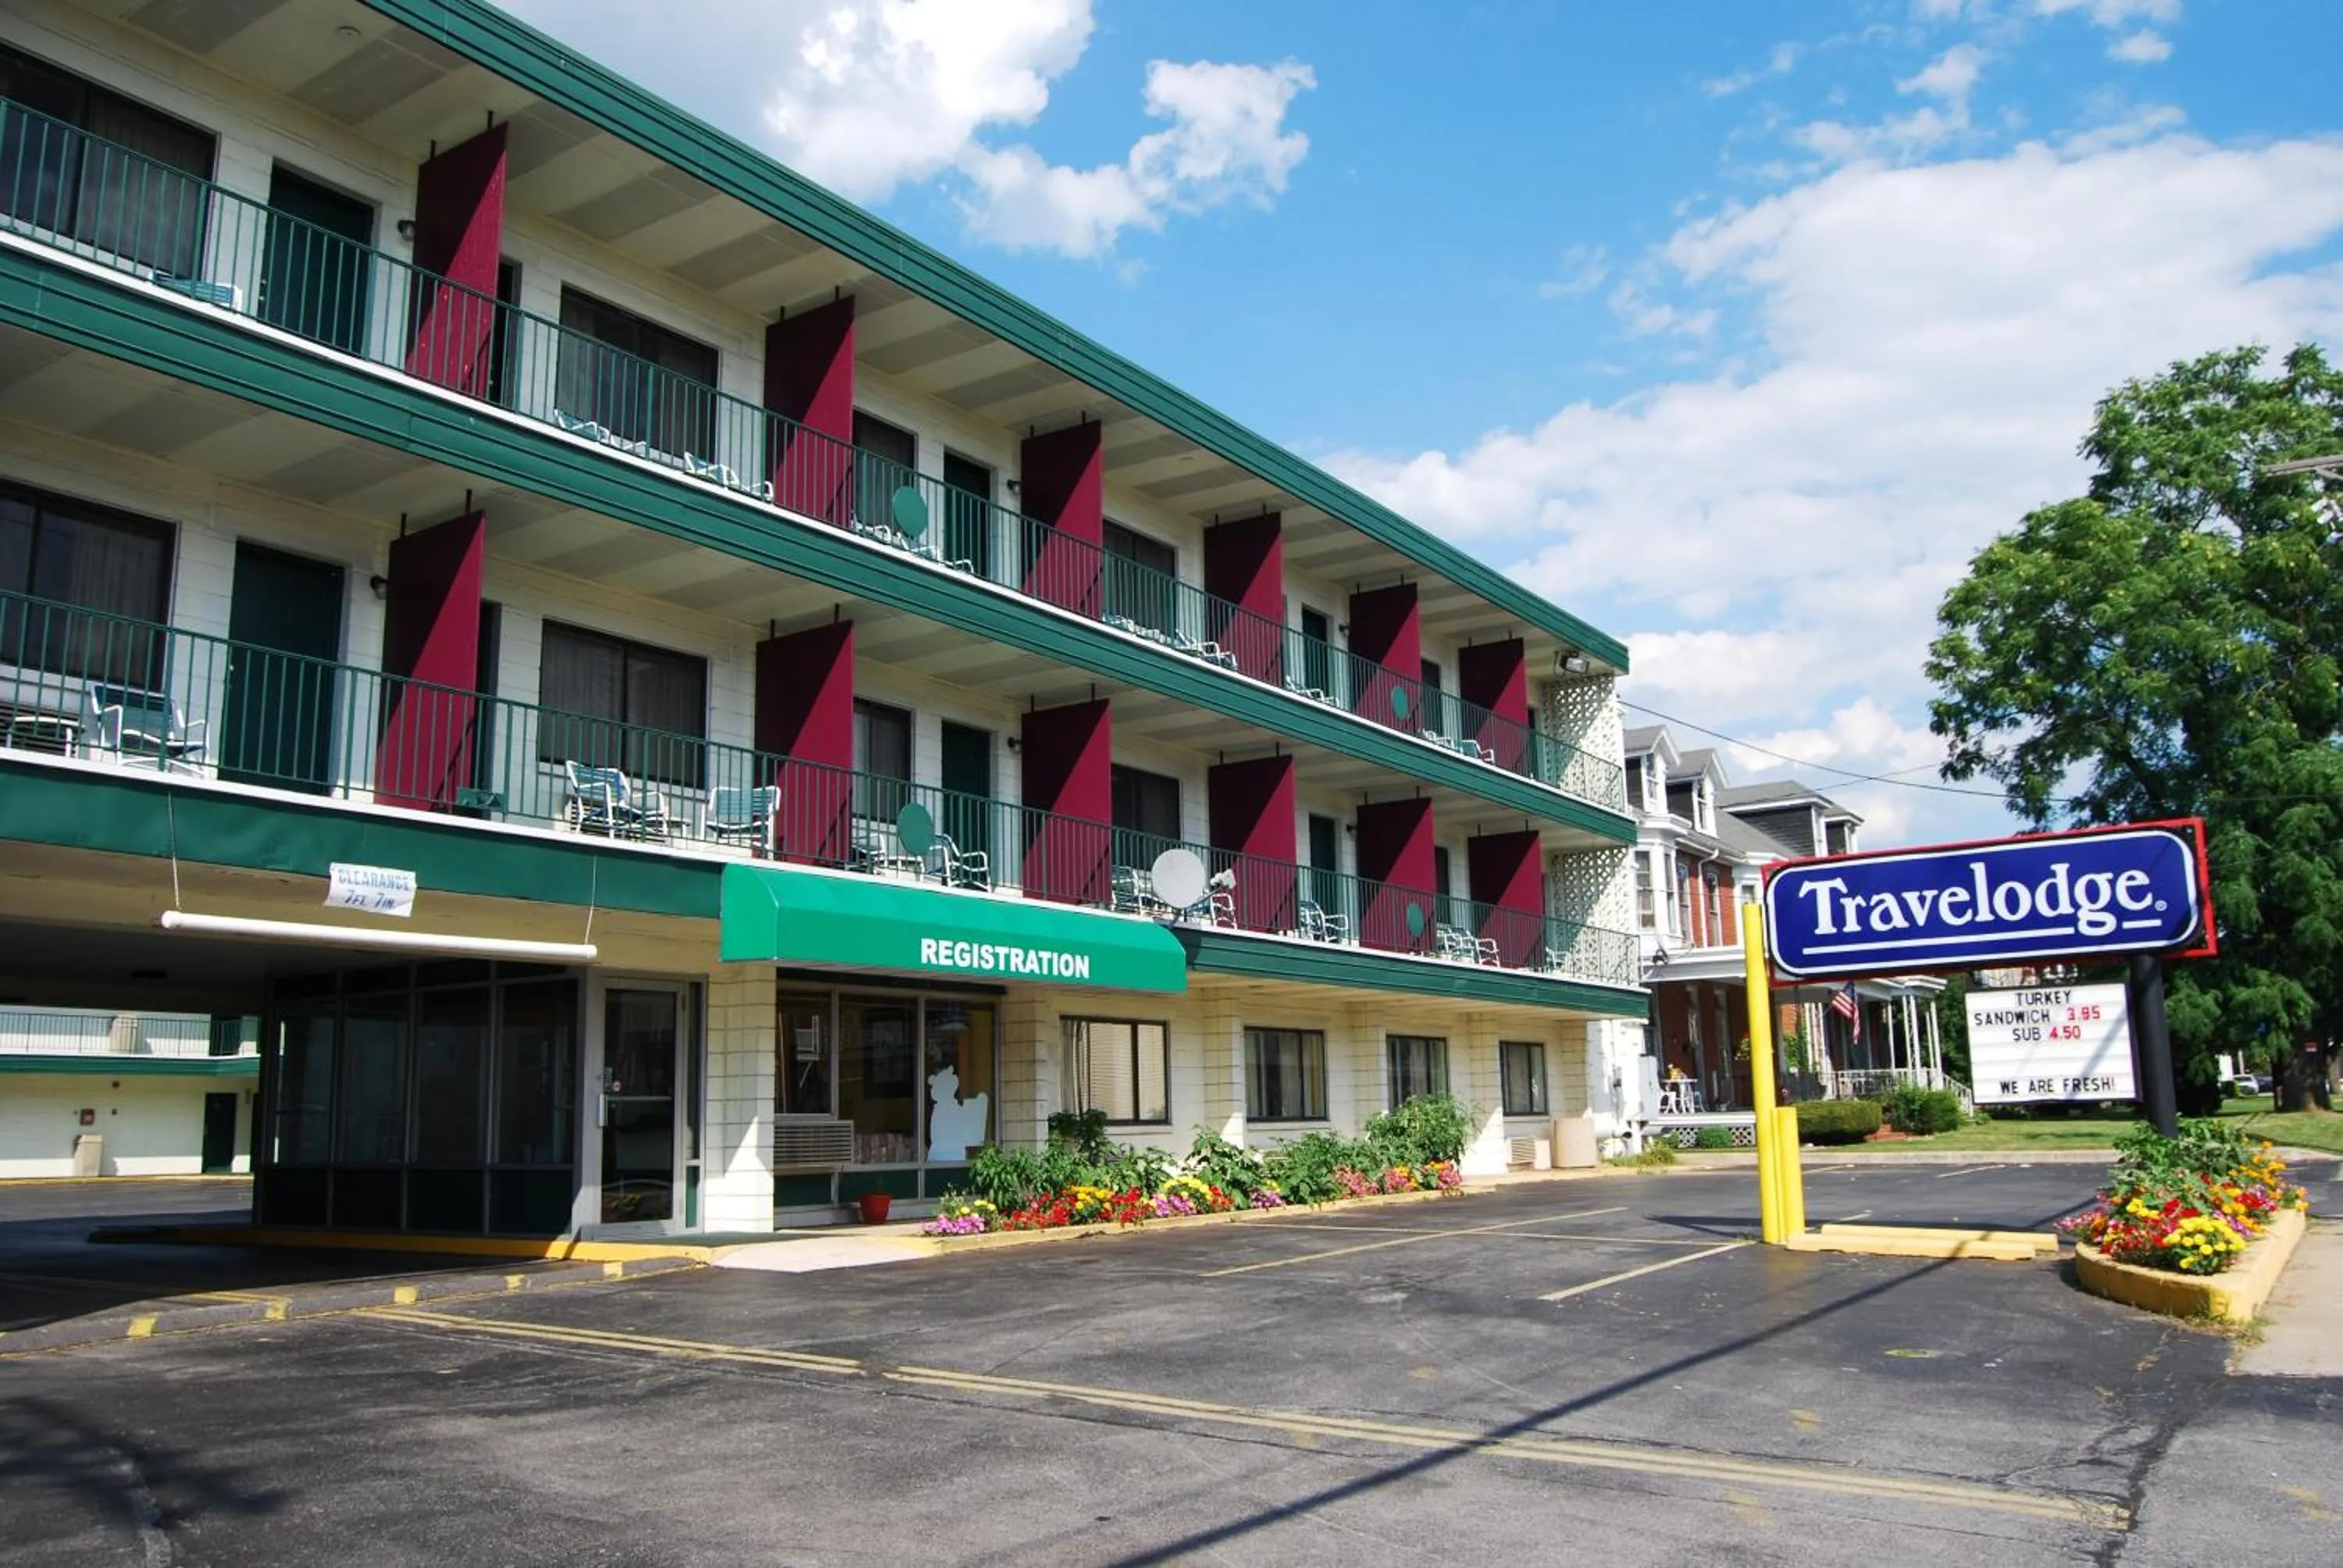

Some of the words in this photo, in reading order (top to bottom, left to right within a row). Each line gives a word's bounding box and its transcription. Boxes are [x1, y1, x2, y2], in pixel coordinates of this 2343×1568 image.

[337, 868, 409, 891] CLEARANCE
[1799, 861, 2152, 936] Travelodge
[921, 938, 1089, 978] REGISTRATION
[2016, 990, 2071, 1006] TURKEY
[1974, 1010, 2050, 1026] SANDWICH
[2013, 1027, 2042, 1041] SUB
[2049, 1025, 2081, 1040] 4.50
[2000, 1081, 2018, 1094] WE
[2028, 1078, 2054, 1093] ARE
[2063, 1076, 2116, 1092] FRESH!
